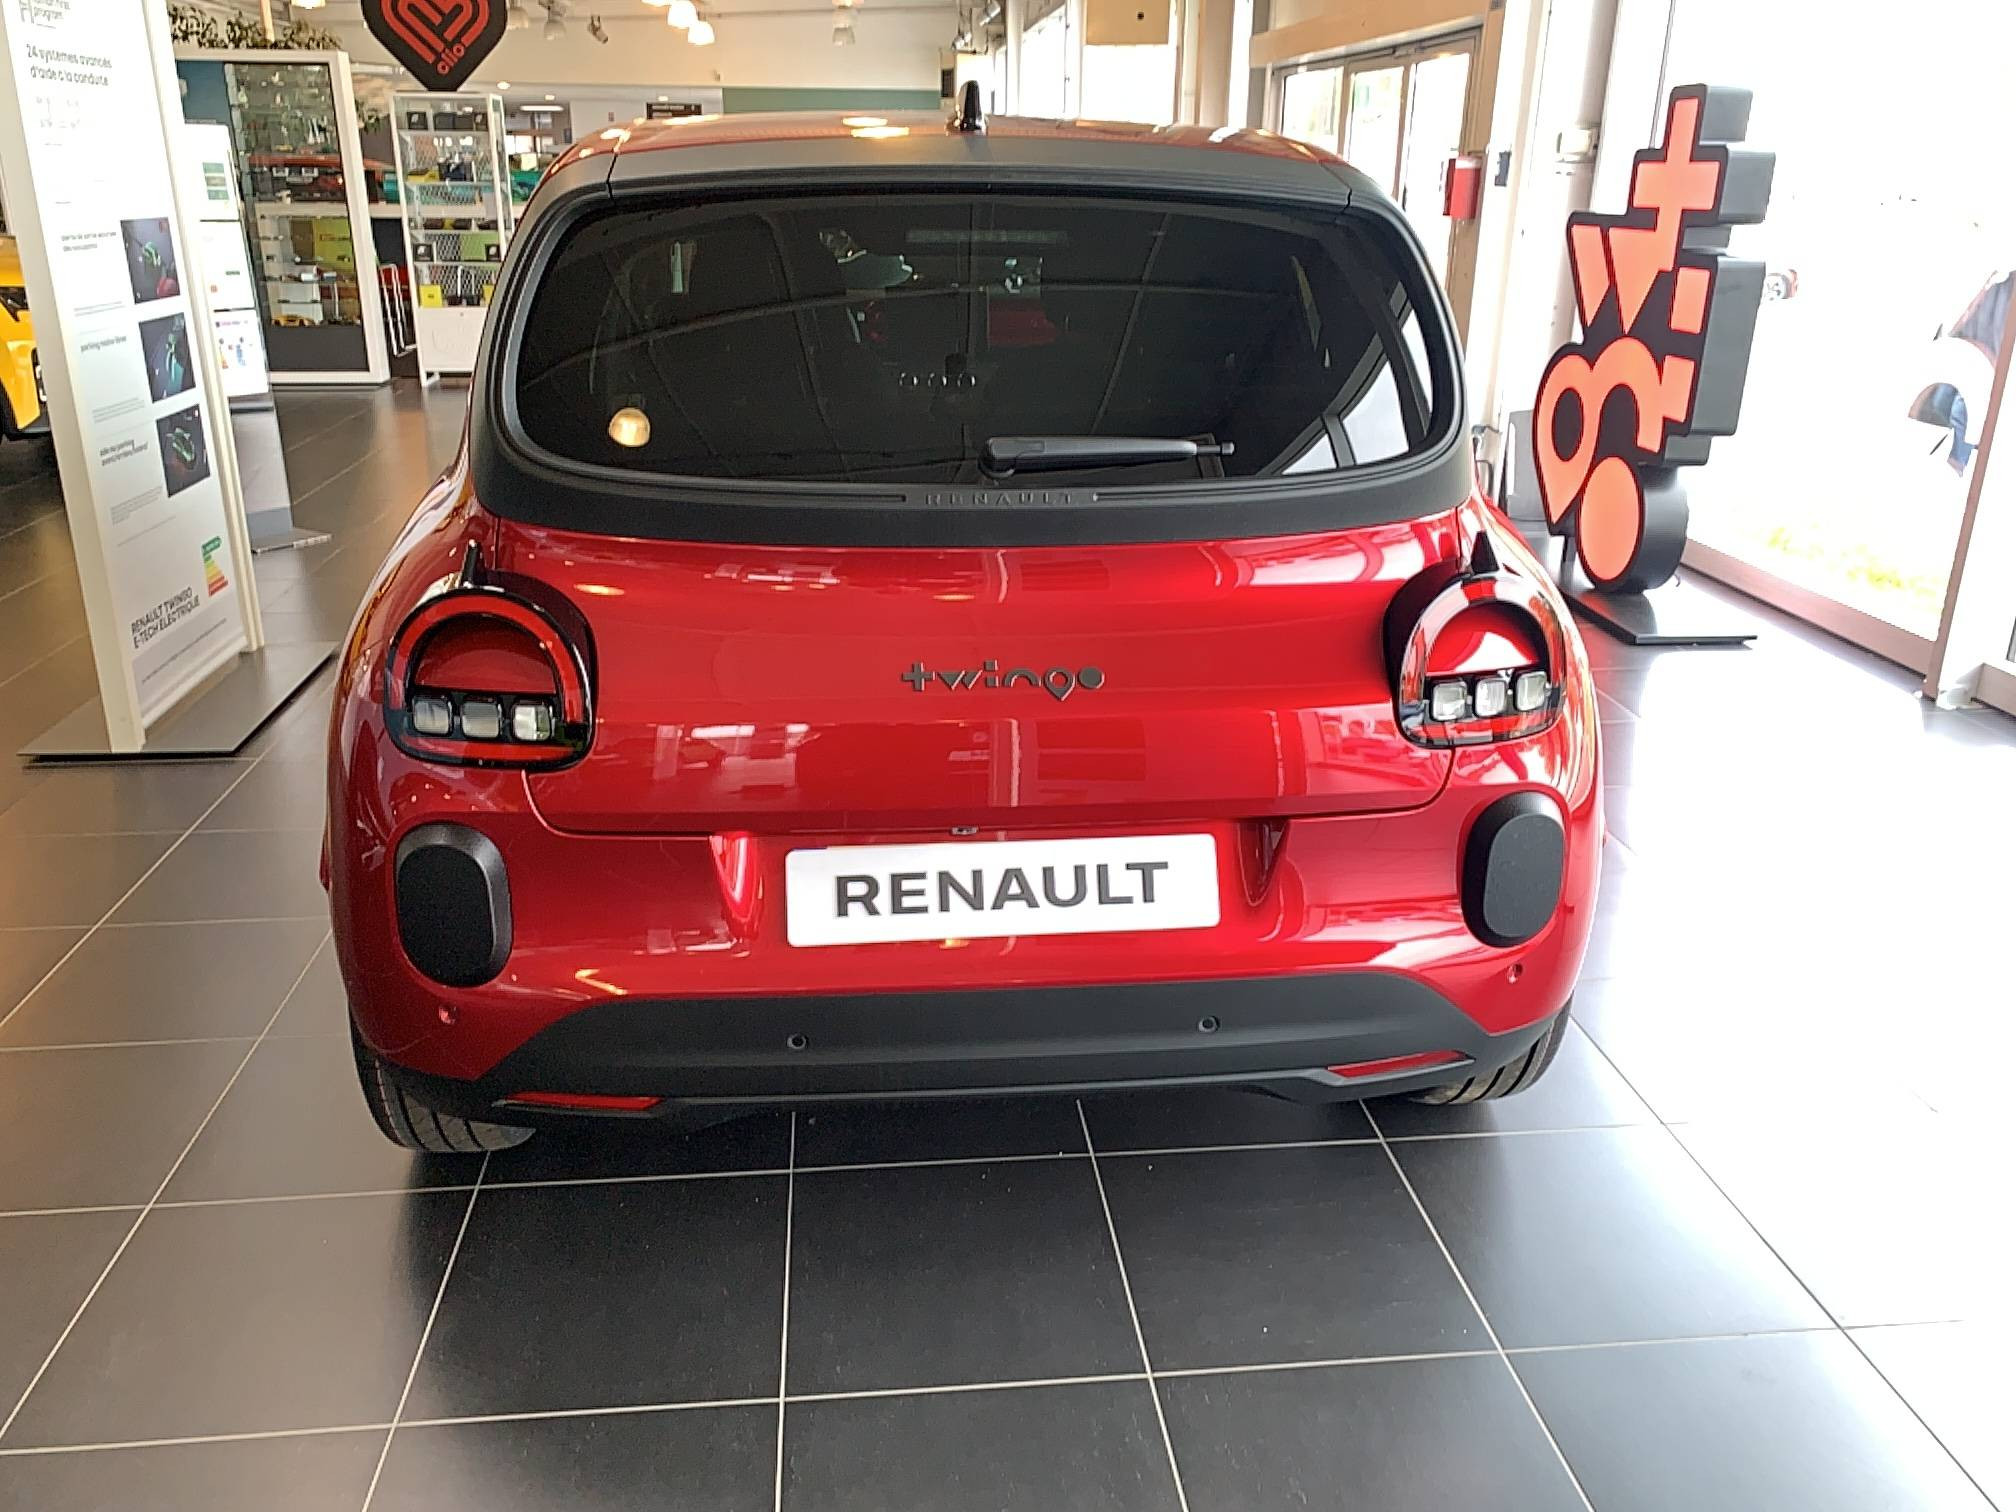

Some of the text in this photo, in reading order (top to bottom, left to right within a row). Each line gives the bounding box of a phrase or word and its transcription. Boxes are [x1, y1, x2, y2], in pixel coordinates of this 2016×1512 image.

[925, 492, 1074, 506] RENAULT
[131, 586, 193, 636] RENAULT TWINGO
[835, 861, 1169, 918] RENAULT
